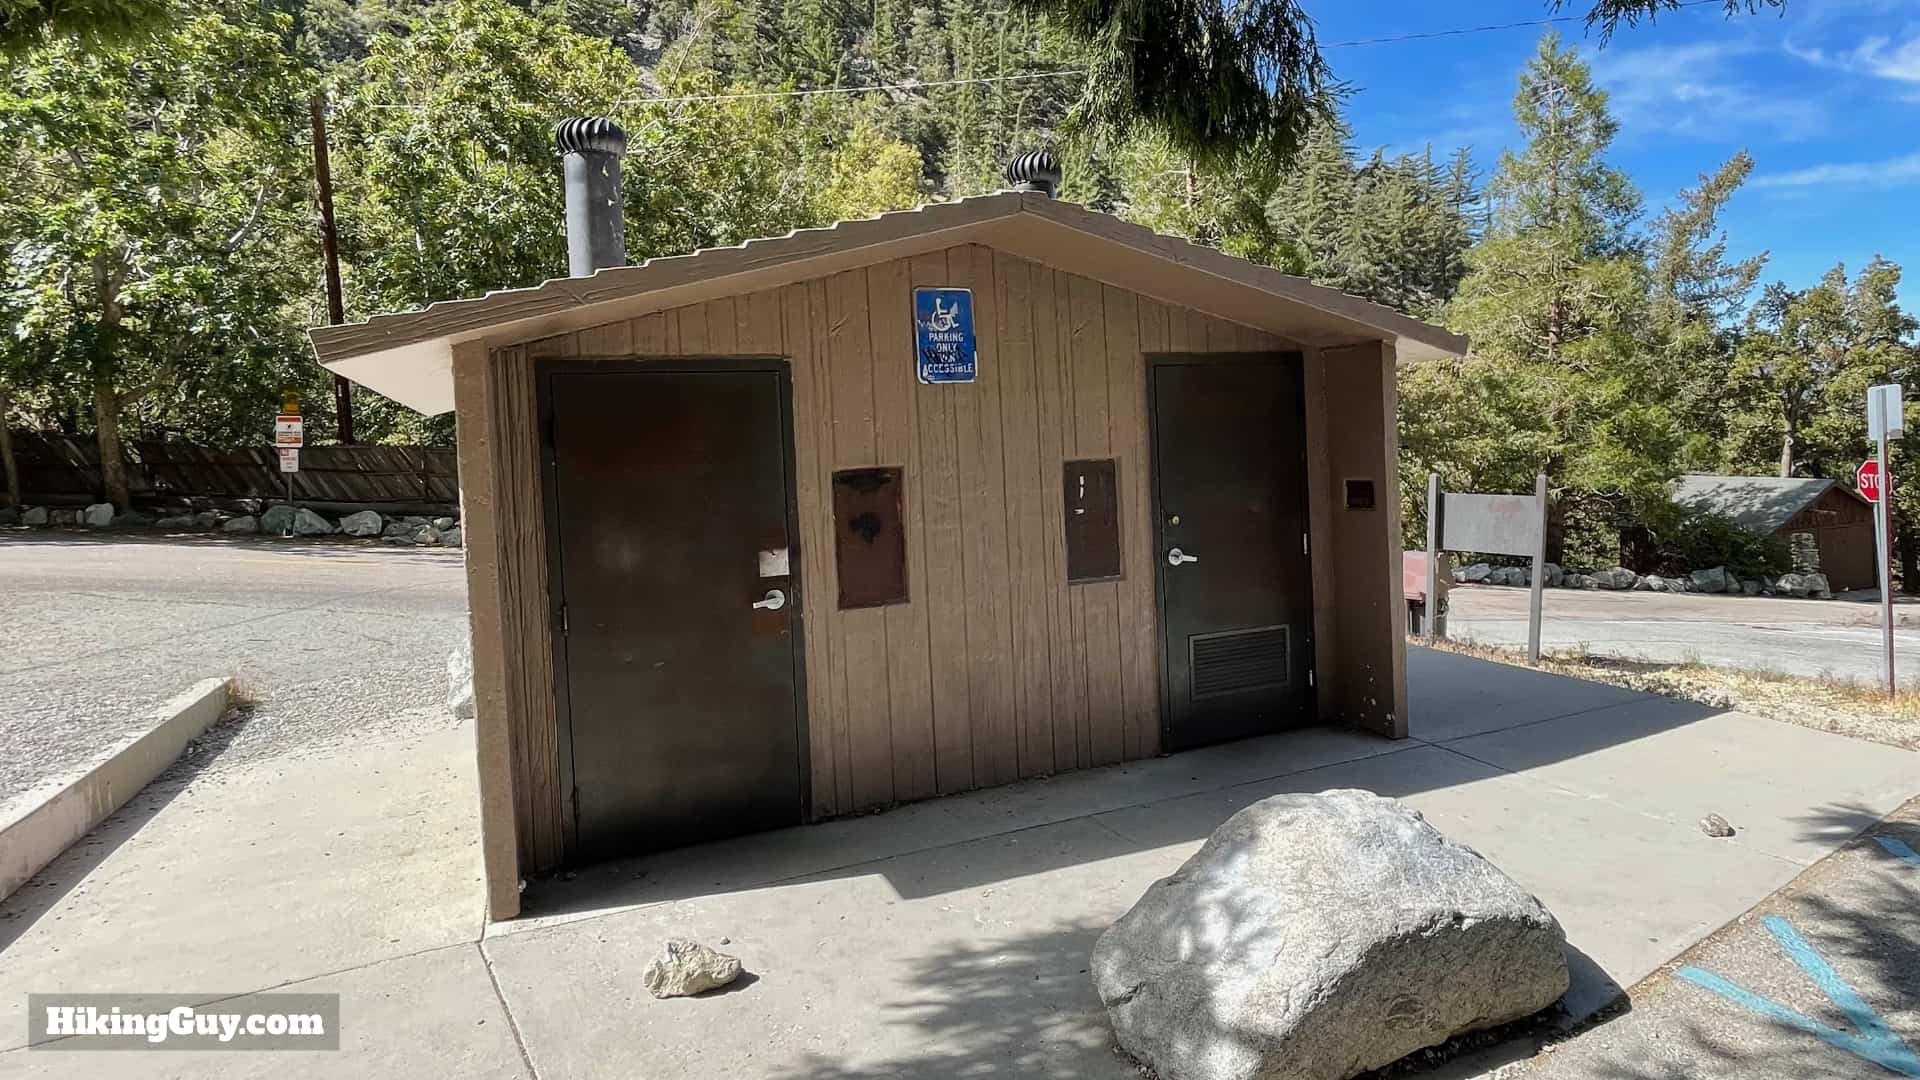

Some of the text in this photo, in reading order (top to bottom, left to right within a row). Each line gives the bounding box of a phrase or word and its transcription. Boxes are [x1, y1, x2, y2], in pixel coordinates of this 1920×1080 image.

[929, 332, 964, 342] PARKING
[936, 343, 957, 352] ONLY
[923, 363, 973, 375] ACCESSIBLE
[1860, 473, 1880, 489] STO
